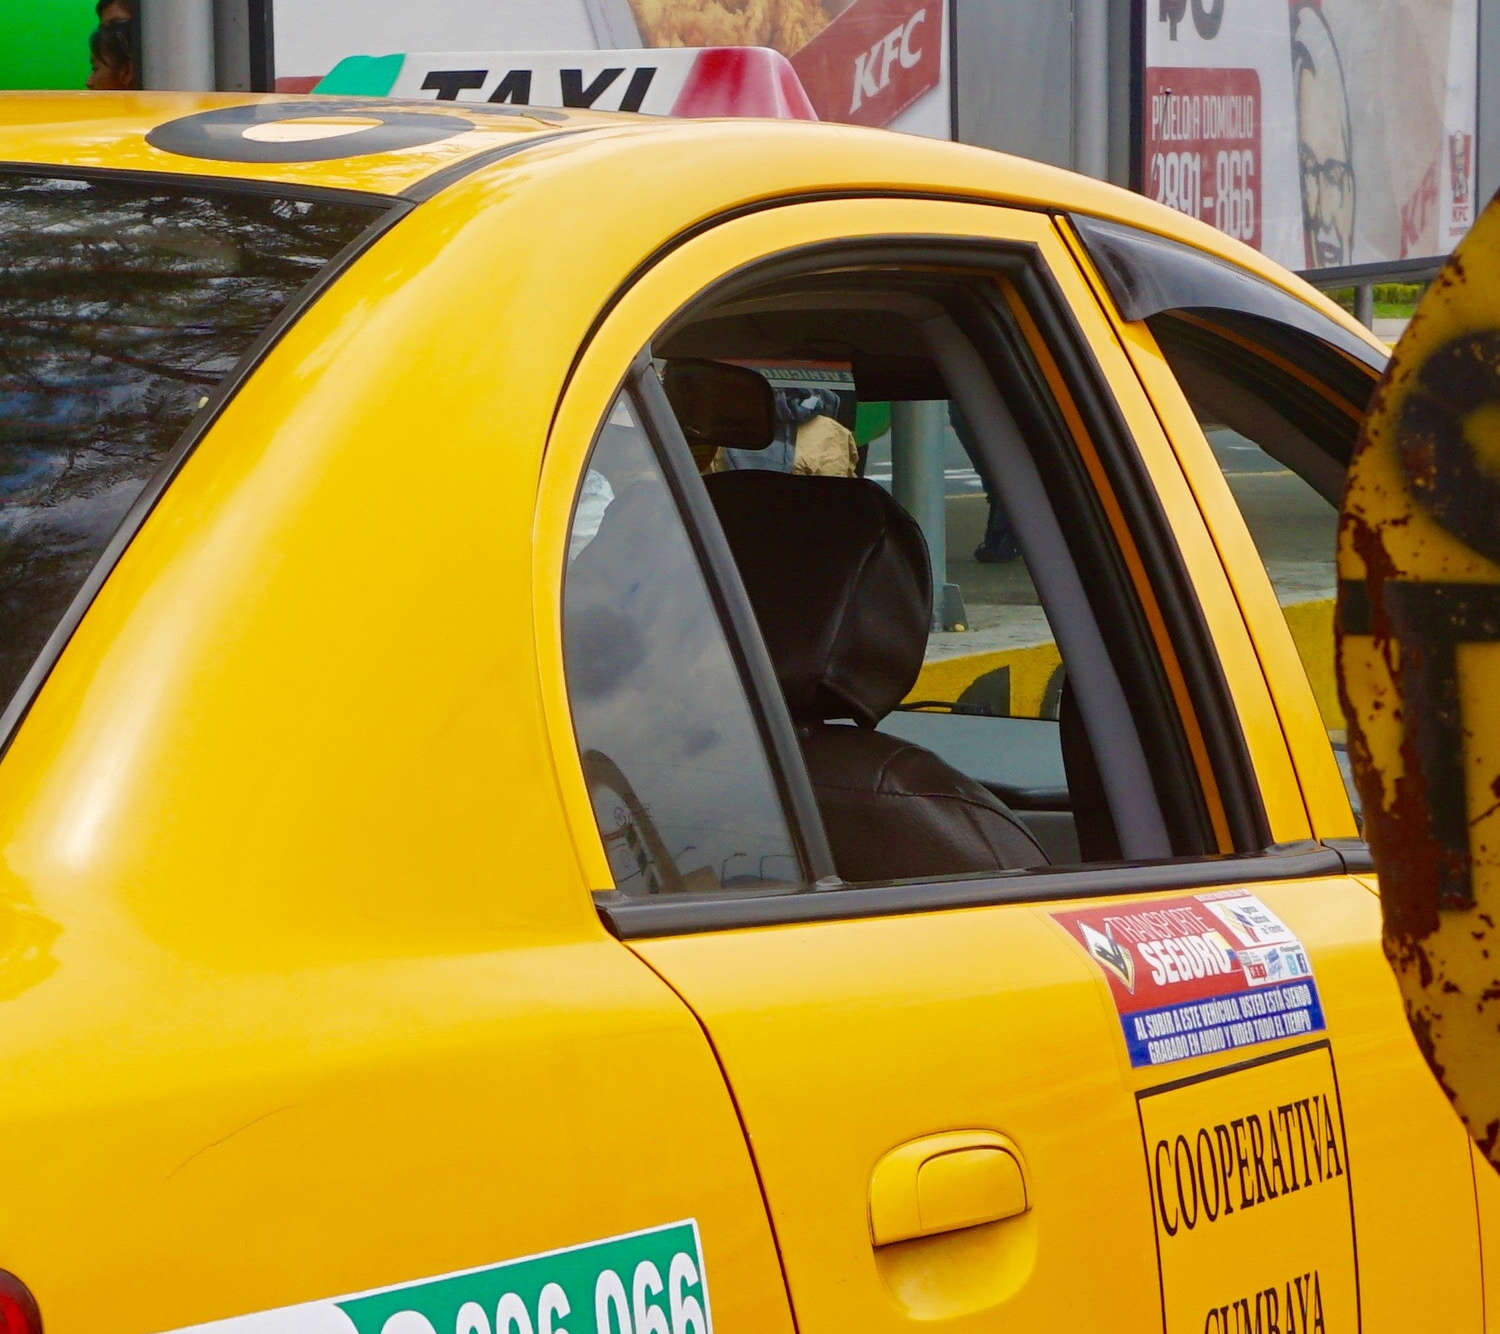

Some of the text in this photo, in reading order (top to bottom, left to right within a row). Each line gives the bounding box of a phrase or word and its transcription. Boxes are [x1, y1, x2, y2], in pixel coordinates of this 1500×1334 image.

[848, 8, 926, 116] KFC
[1202, 95, 1254, 140] DOMICILIO
[1103, 907, 1216, 944] TRANSPORTE
[1137, 931, 1233, 987] SEGURO
[1134, 1017, 1148, 1041] AL
[1145, 1011, 1174, 1038] SUBIR
[1172, 1011, 1183, 1032] A
[1180, 1005, 1202, 1029] ESTE
[1239, 993, 1266, 1018] USTED
[1282, 984, 1312, 1010] SIENDO
[1148, 1008, 1312, 1065] GRABADO EN AUDIO Y VIDEO TODO EL TIEMPO
[1154, 1093, 1343, 1237] COOPERATIVA
